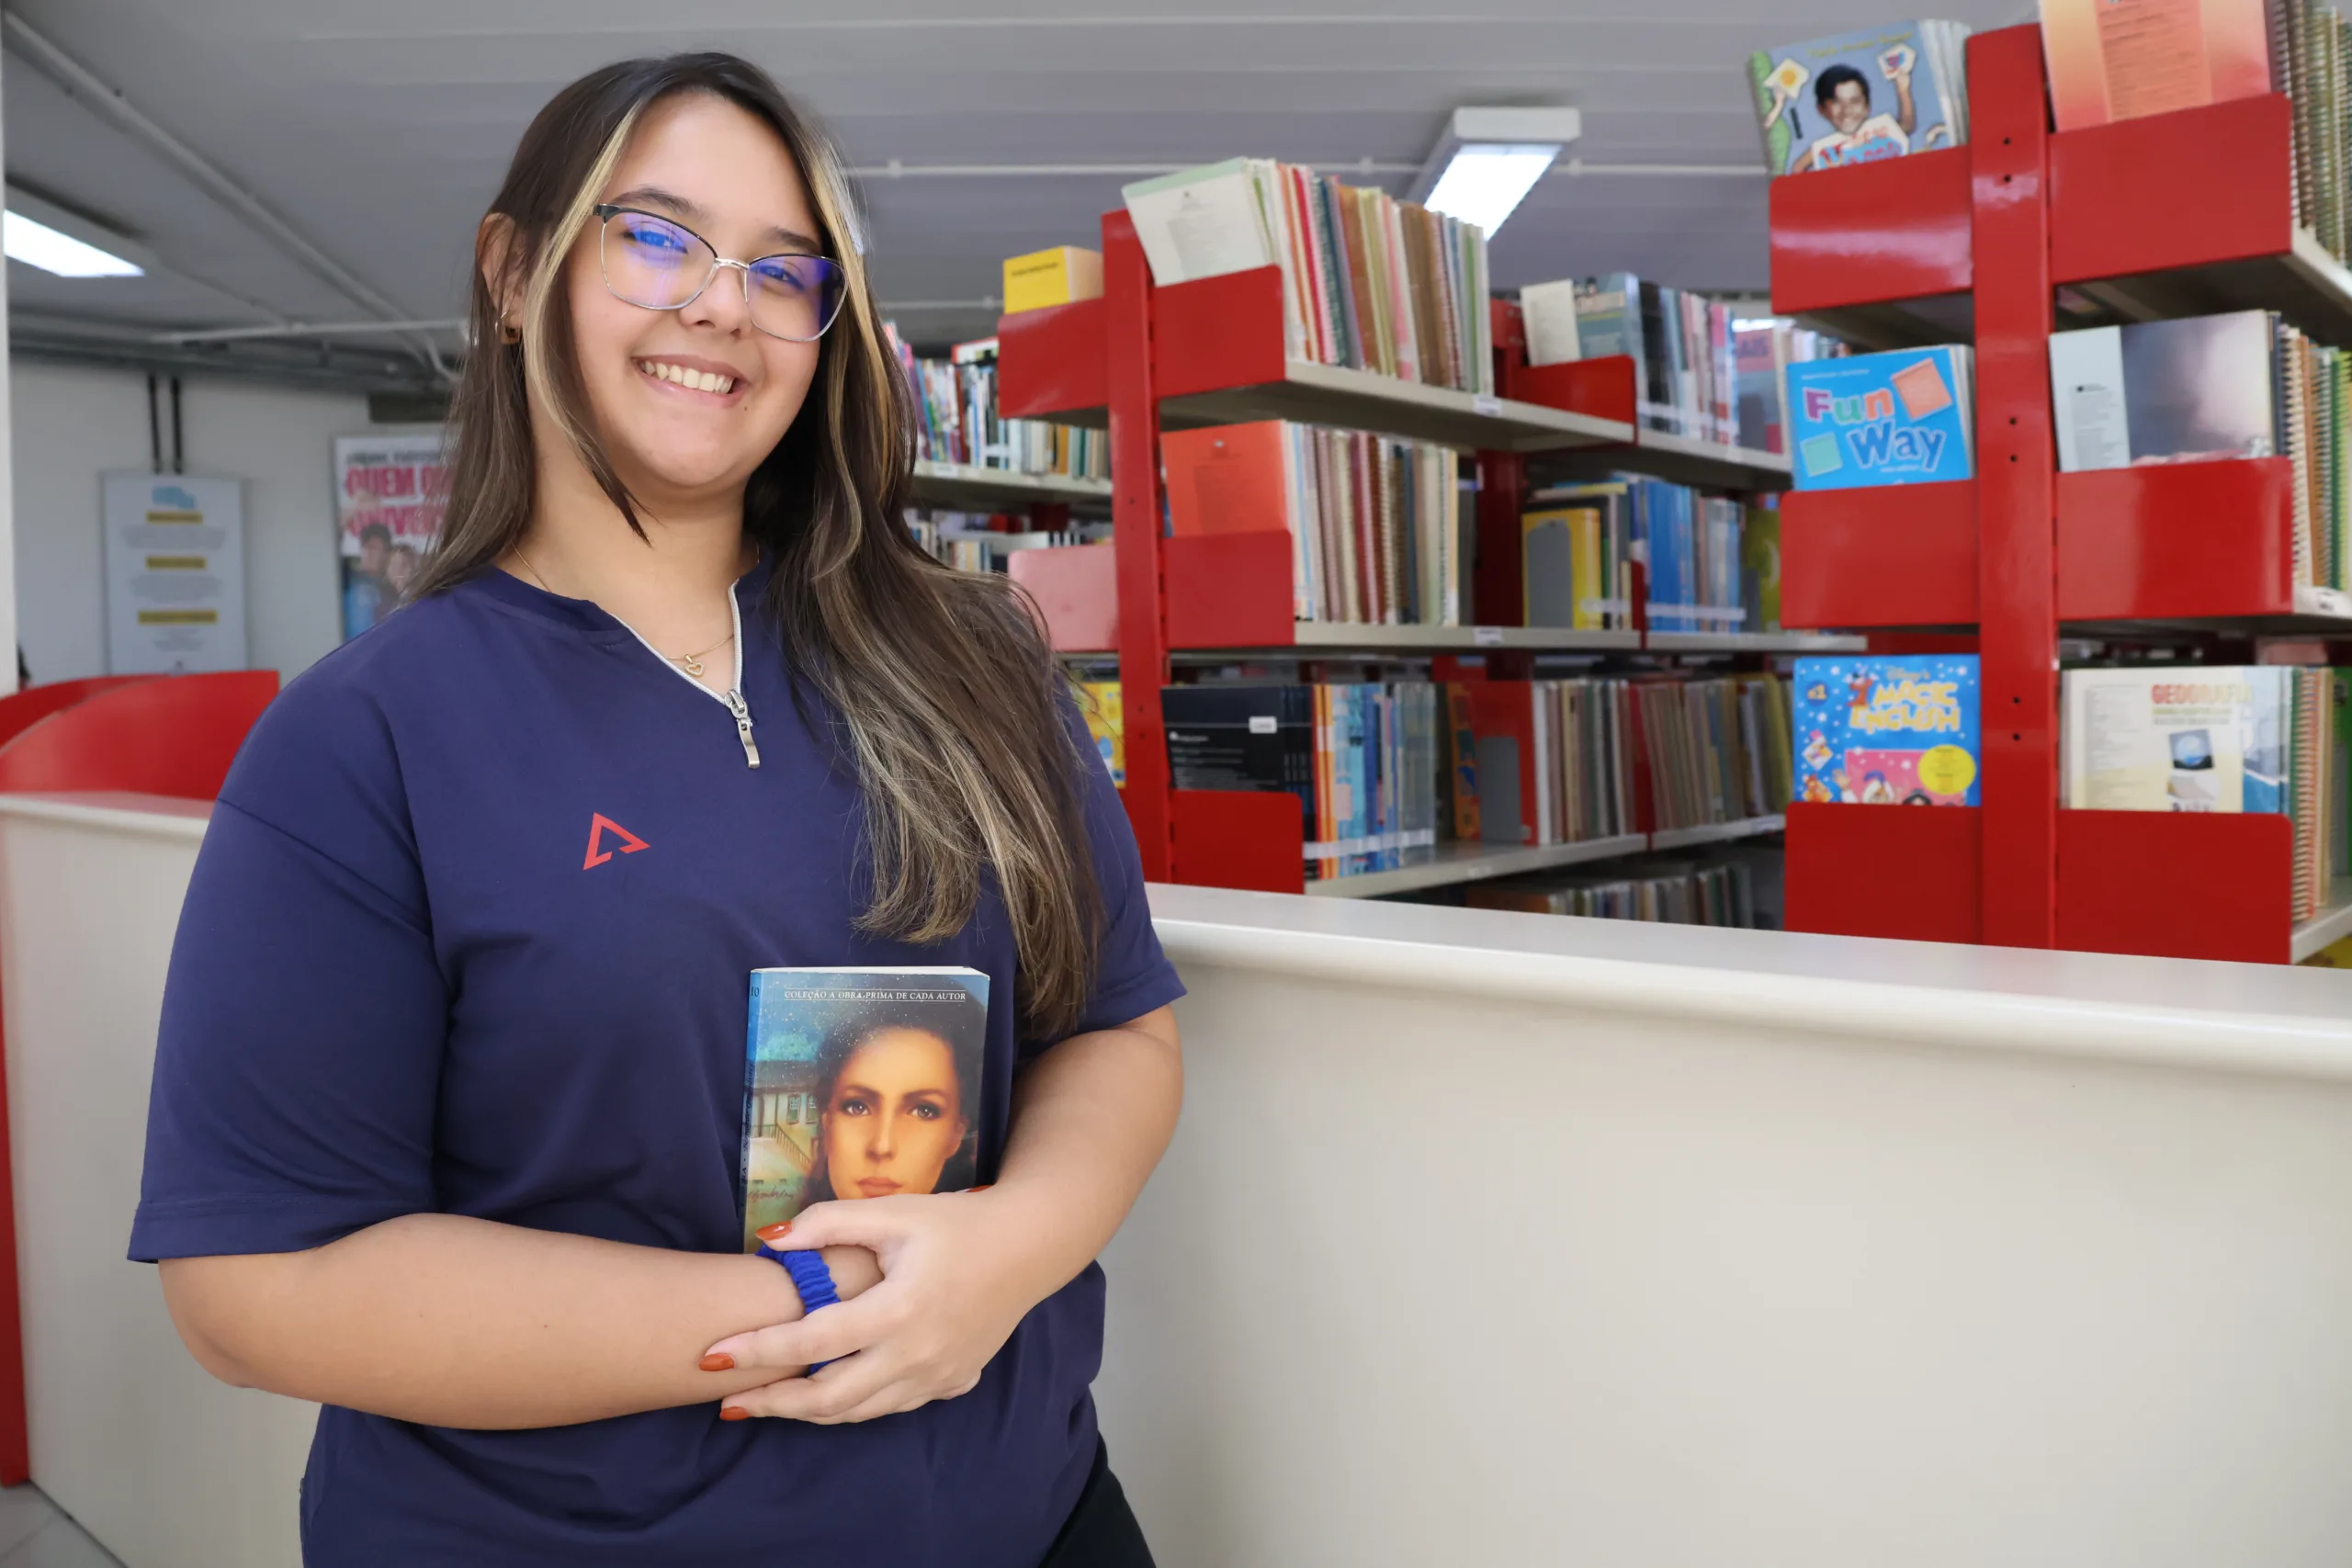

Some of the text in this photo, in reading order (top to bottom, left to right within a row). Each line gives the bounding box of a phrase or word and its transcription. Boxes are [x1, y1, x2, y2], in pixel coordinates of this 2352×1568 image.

[1804, 387, 1894, 423] Fun
[1847, 420, 1946, 472] Way
[1873, 680, 1958, 707] MAGIC
[1849, 705, 1960, 734] ENGLISH
[751, 987, 760, 998] 10
[784, 989, 827, 1000] COLEÇÃO
[838, 991, 894, 999] OBRA-PRIMA
[910, 992, 933, 1000] CADA
